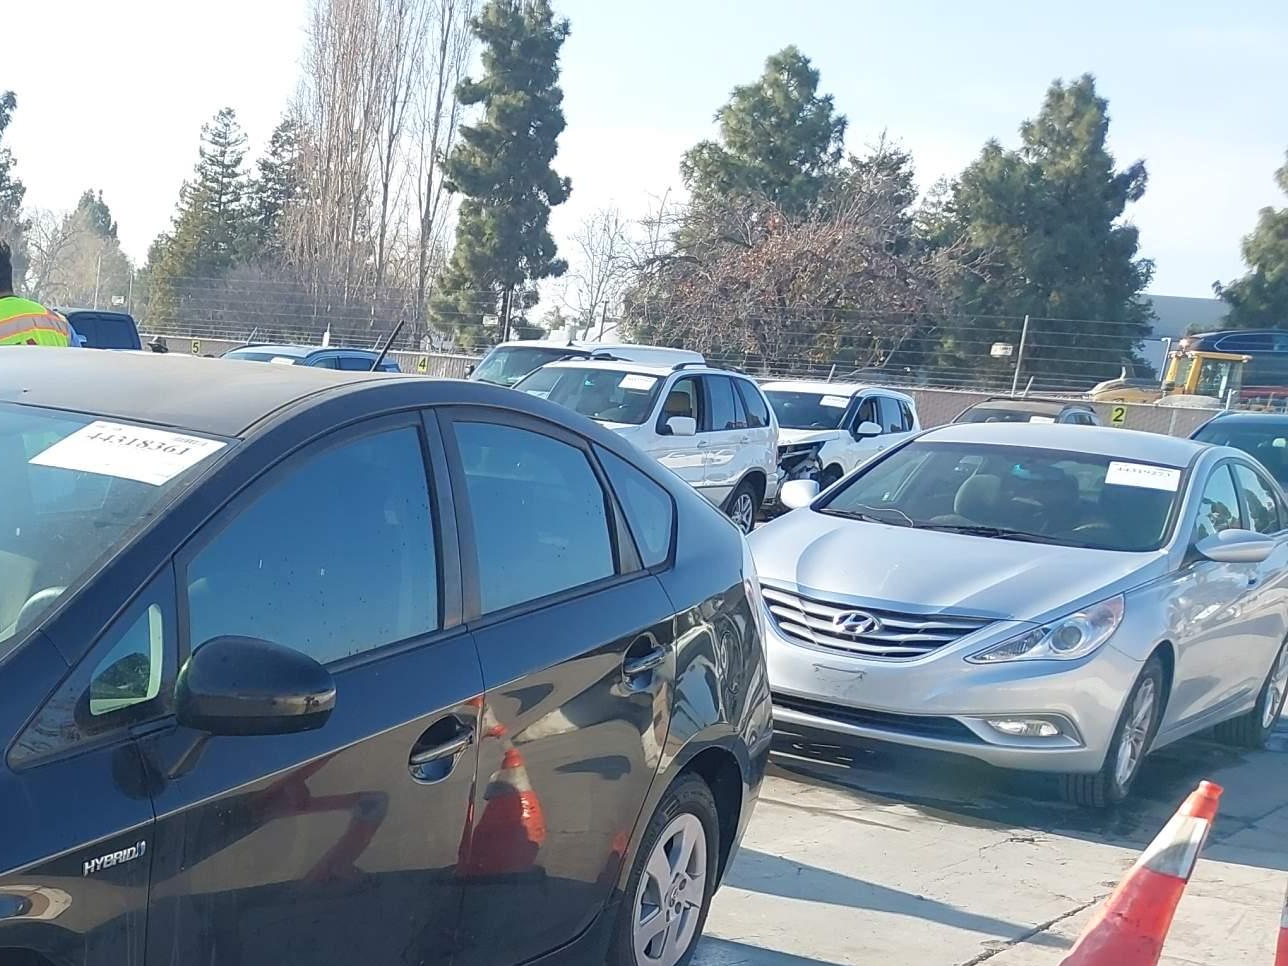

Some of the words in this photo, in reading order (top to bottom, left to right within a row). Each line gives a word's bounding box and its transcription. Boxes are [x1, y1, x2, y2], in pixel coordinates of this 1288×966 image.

[192, 342, 199, 354] 5
[418, 357, 426, 370] 4
[1113, 407, 1125, 422] 2
[86, 432, 191, 456] 44318361
[83, 846, 139, 877] HYBRID
